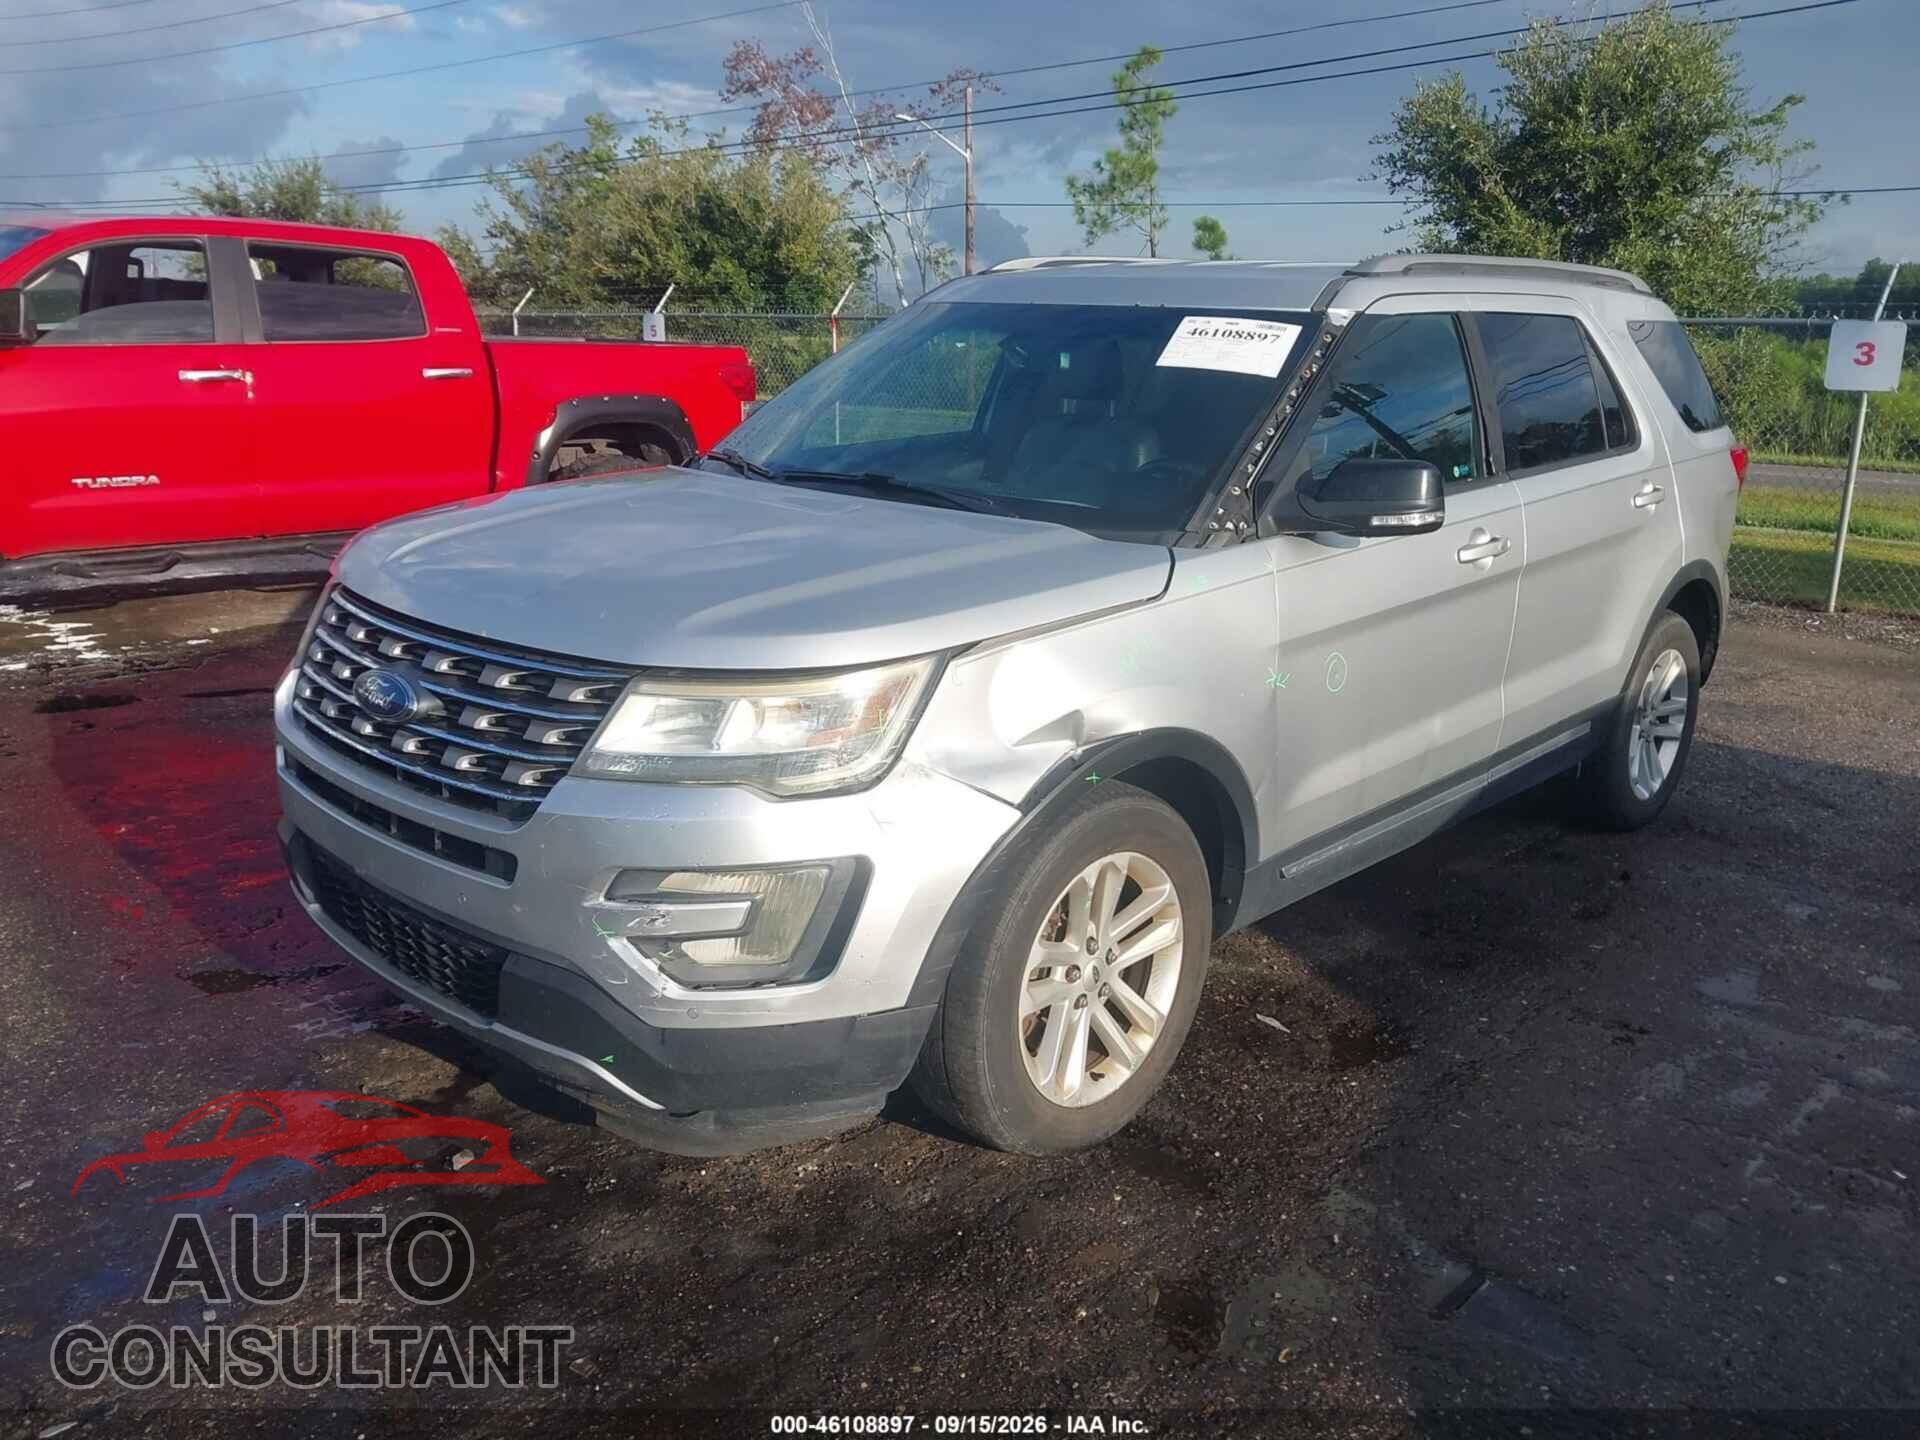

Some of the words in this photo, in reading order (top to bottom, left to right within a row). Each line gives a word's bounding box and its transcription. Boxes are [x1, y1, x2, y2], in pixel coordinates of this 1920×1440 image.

[650, 325, 657, 337] 5
[1186, 327, 1281, 344] 46108897
[1853, 342, 1876, 366] 3
[71, 475, 160, 488] TUNDRA
